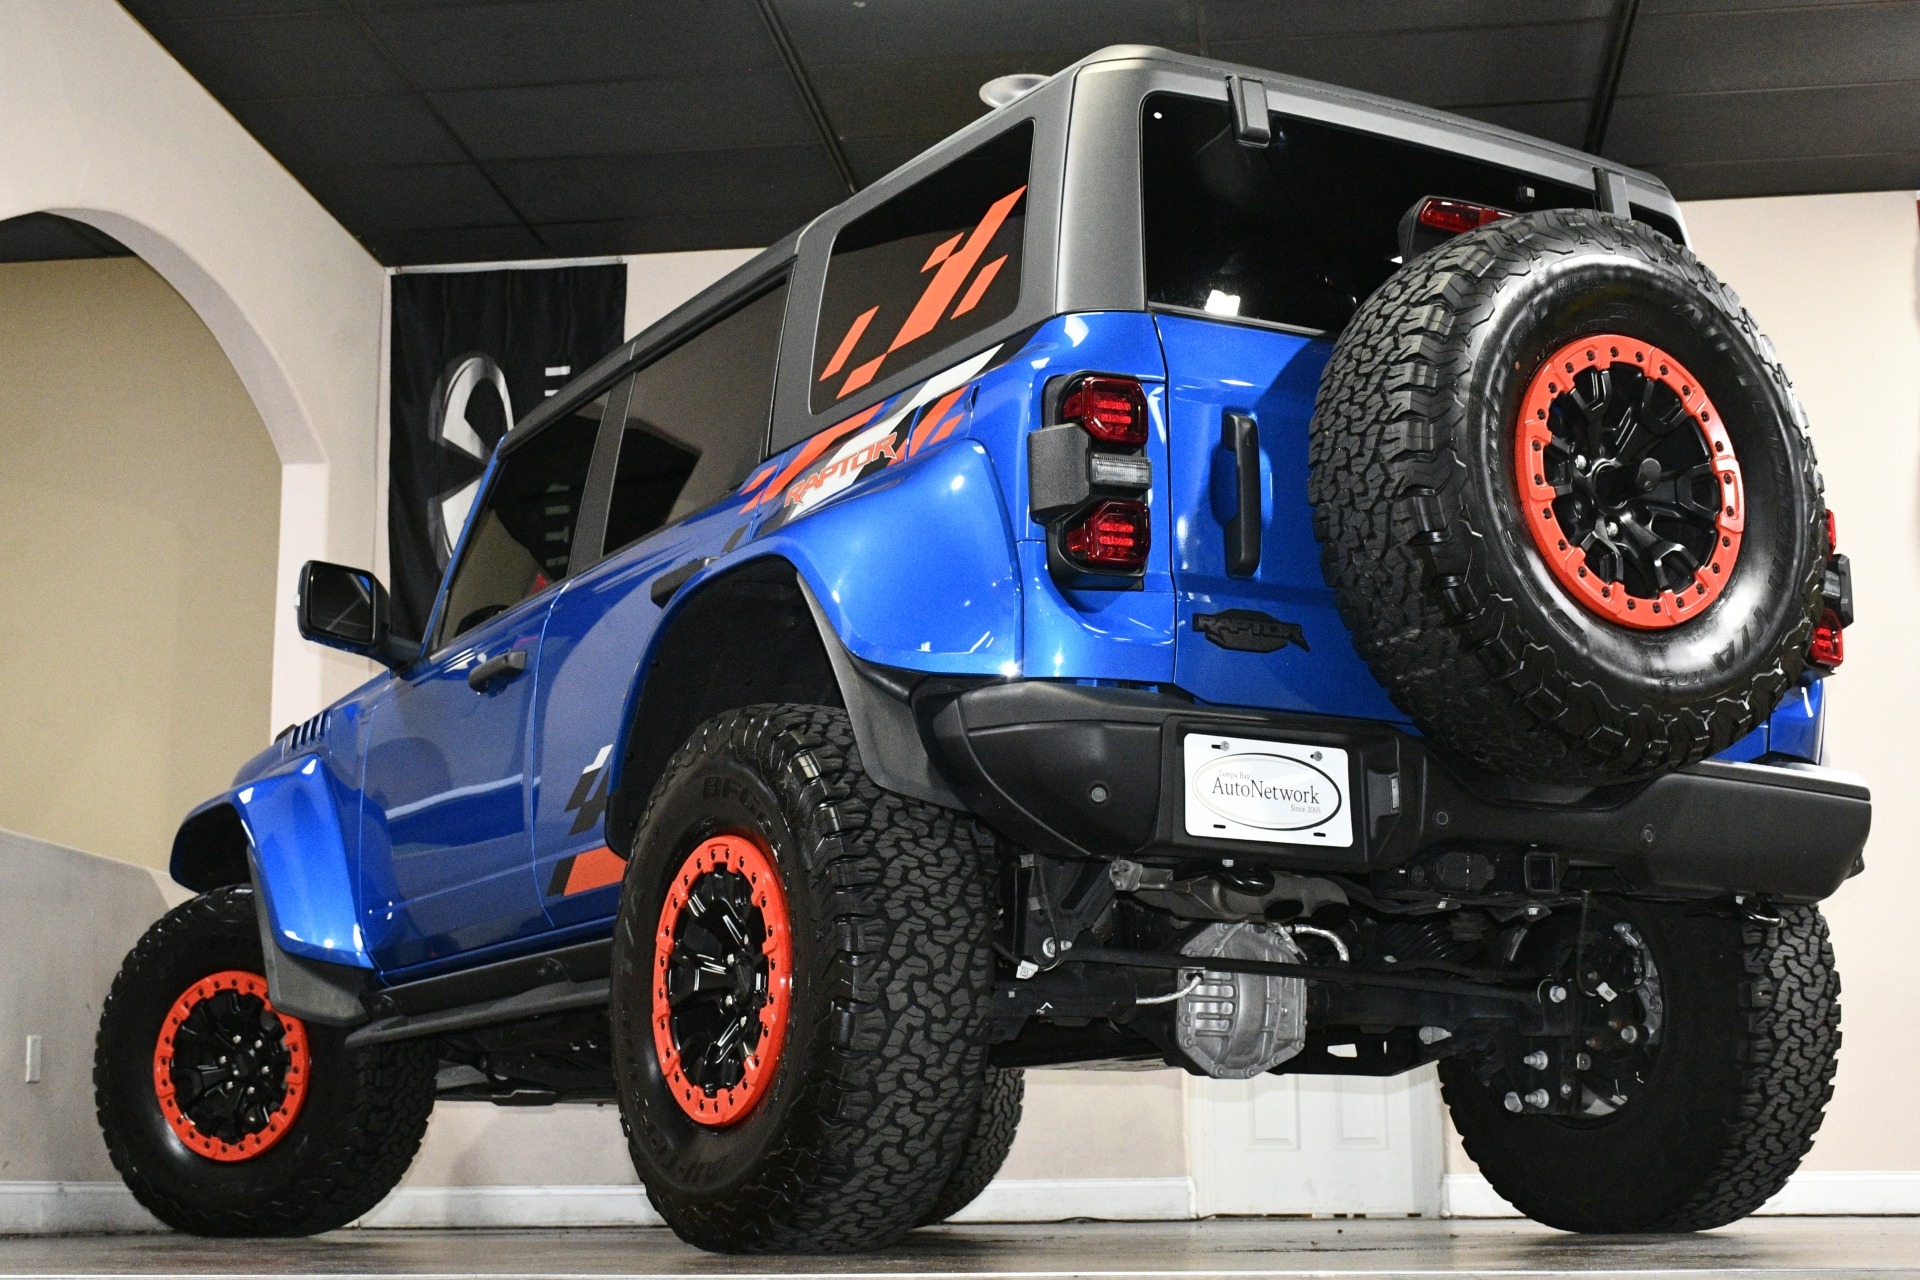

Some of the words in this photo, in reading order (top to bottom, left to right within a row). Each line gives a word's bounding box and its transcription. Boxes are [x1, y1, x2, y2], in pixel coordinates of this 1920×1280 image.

[783, 431, 898, 508] RAPTOR
[1193, 612, 1311, 653] RAPTOR
[1218, 769, 1238, 780] Tampa
[1239, 771, 1251, 780] Bay
[1212, 776, 1320, 804] AutoNetwork
[1290, 804, 1306, 813] Since
[1307, 806, 1321, 815] 2005
